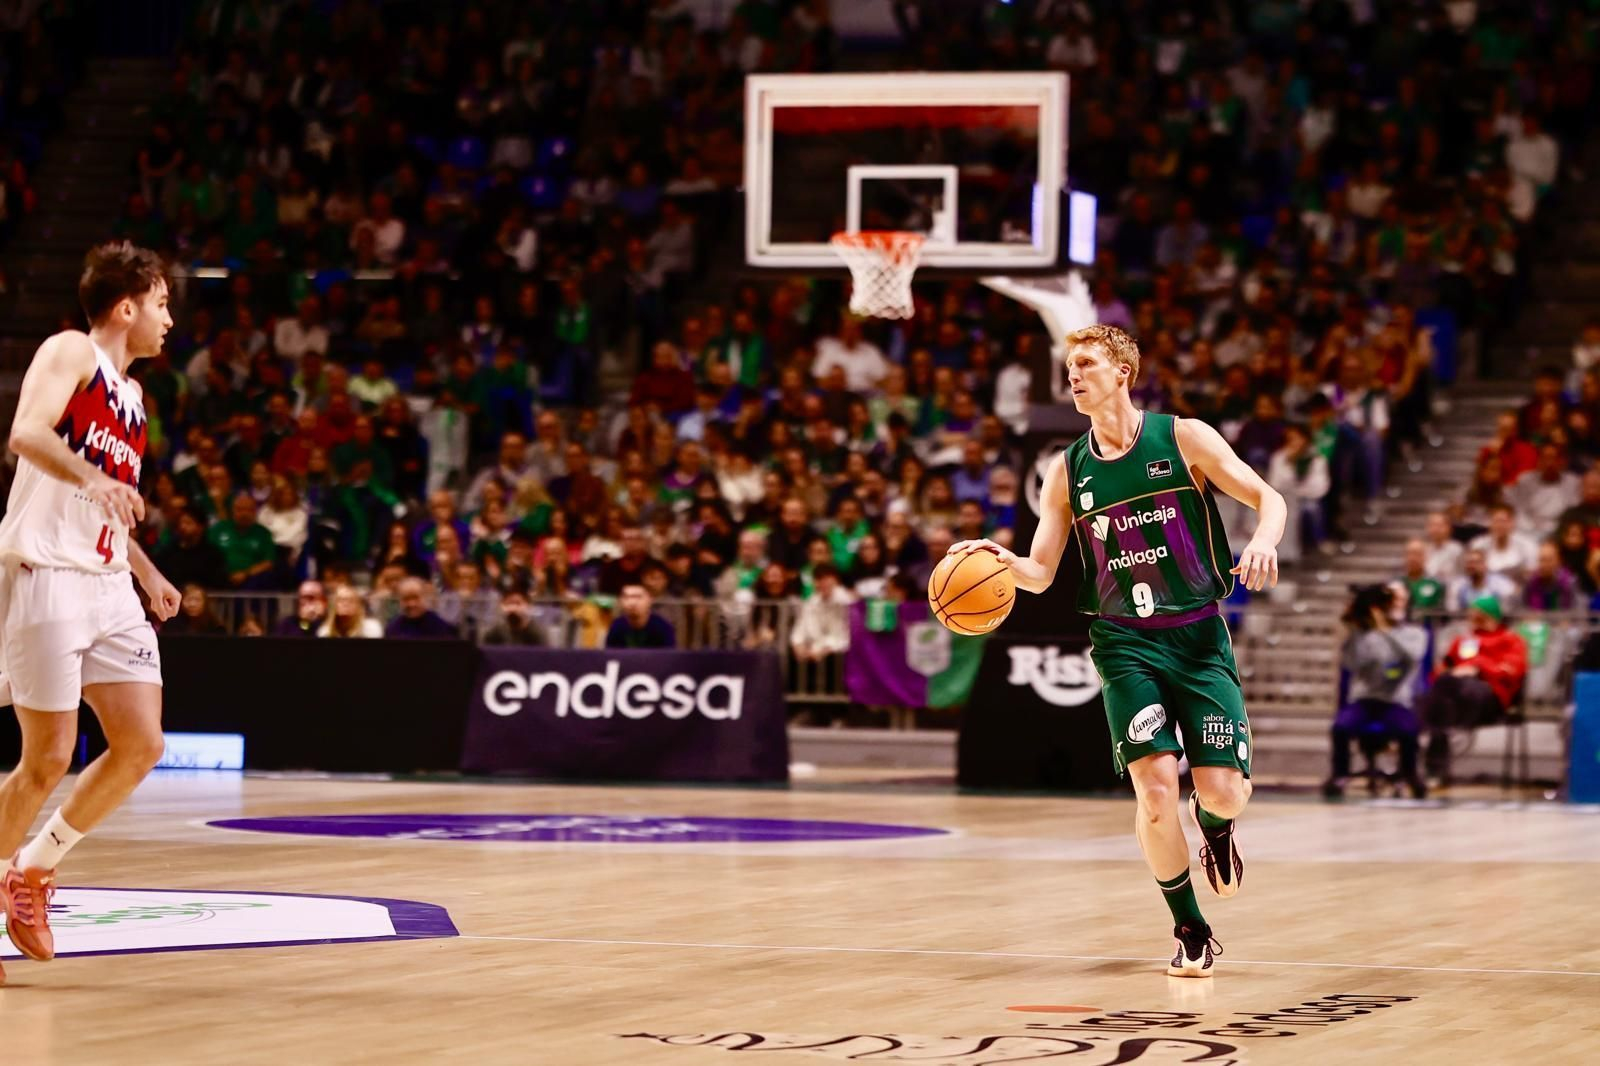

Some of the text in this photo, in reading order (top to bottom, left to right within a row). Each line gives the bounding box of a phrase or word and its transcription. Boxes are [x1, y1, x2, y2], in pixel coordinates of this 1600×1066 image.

[1115, 505, 1176, 532] Unicaja
[96, 524, 114, 565] 4
[1107, 545, 1168, 571] málaga
[1132, 582, 1155, 618] 9
[483, 660, 745, 720] endesa
[1203, 714, 1225, 722] sabor
[1026, 1010, 1204, 1033] liga
[1199, 994, 1419, 1038] endesa
